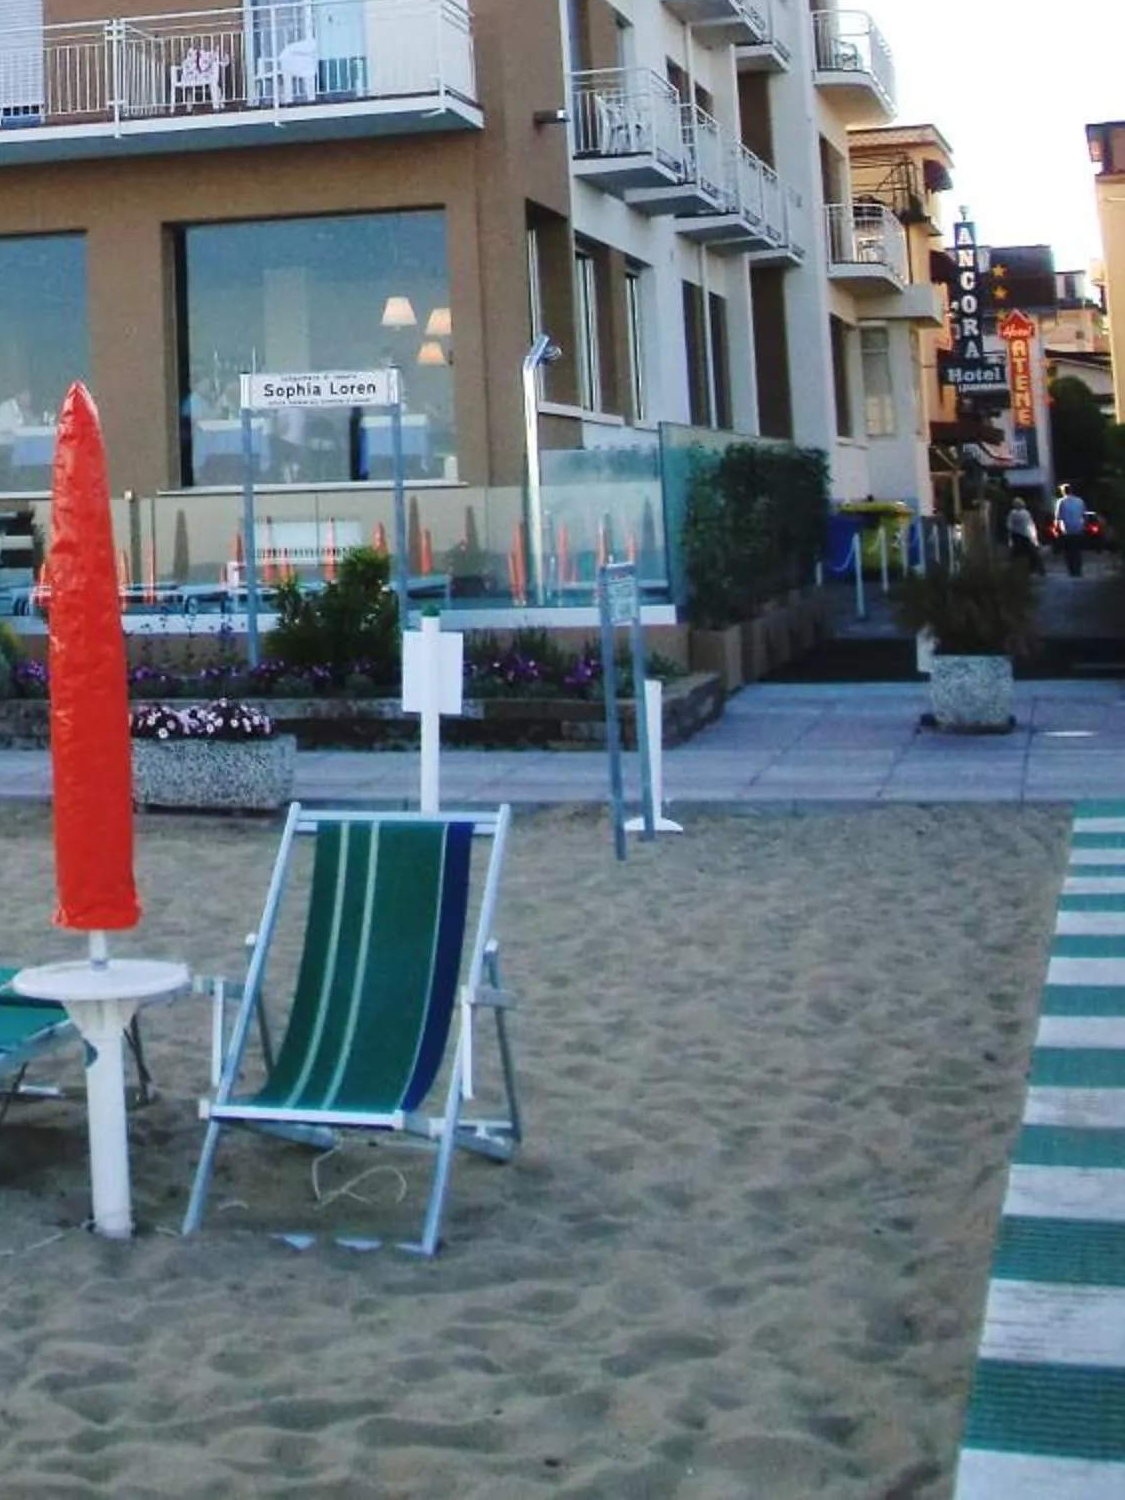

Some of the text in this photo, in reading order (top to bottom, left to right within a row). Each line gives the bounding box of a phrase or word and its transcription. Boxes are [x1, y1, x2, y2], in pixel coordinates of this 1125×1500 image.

[957, 227, 980, 359] ANCORA
[263, 382, 377, 398] Sophia Loren
[948, 366, 1001, 383] Hotel
[1011, 340, 1033, 426] ATENE
